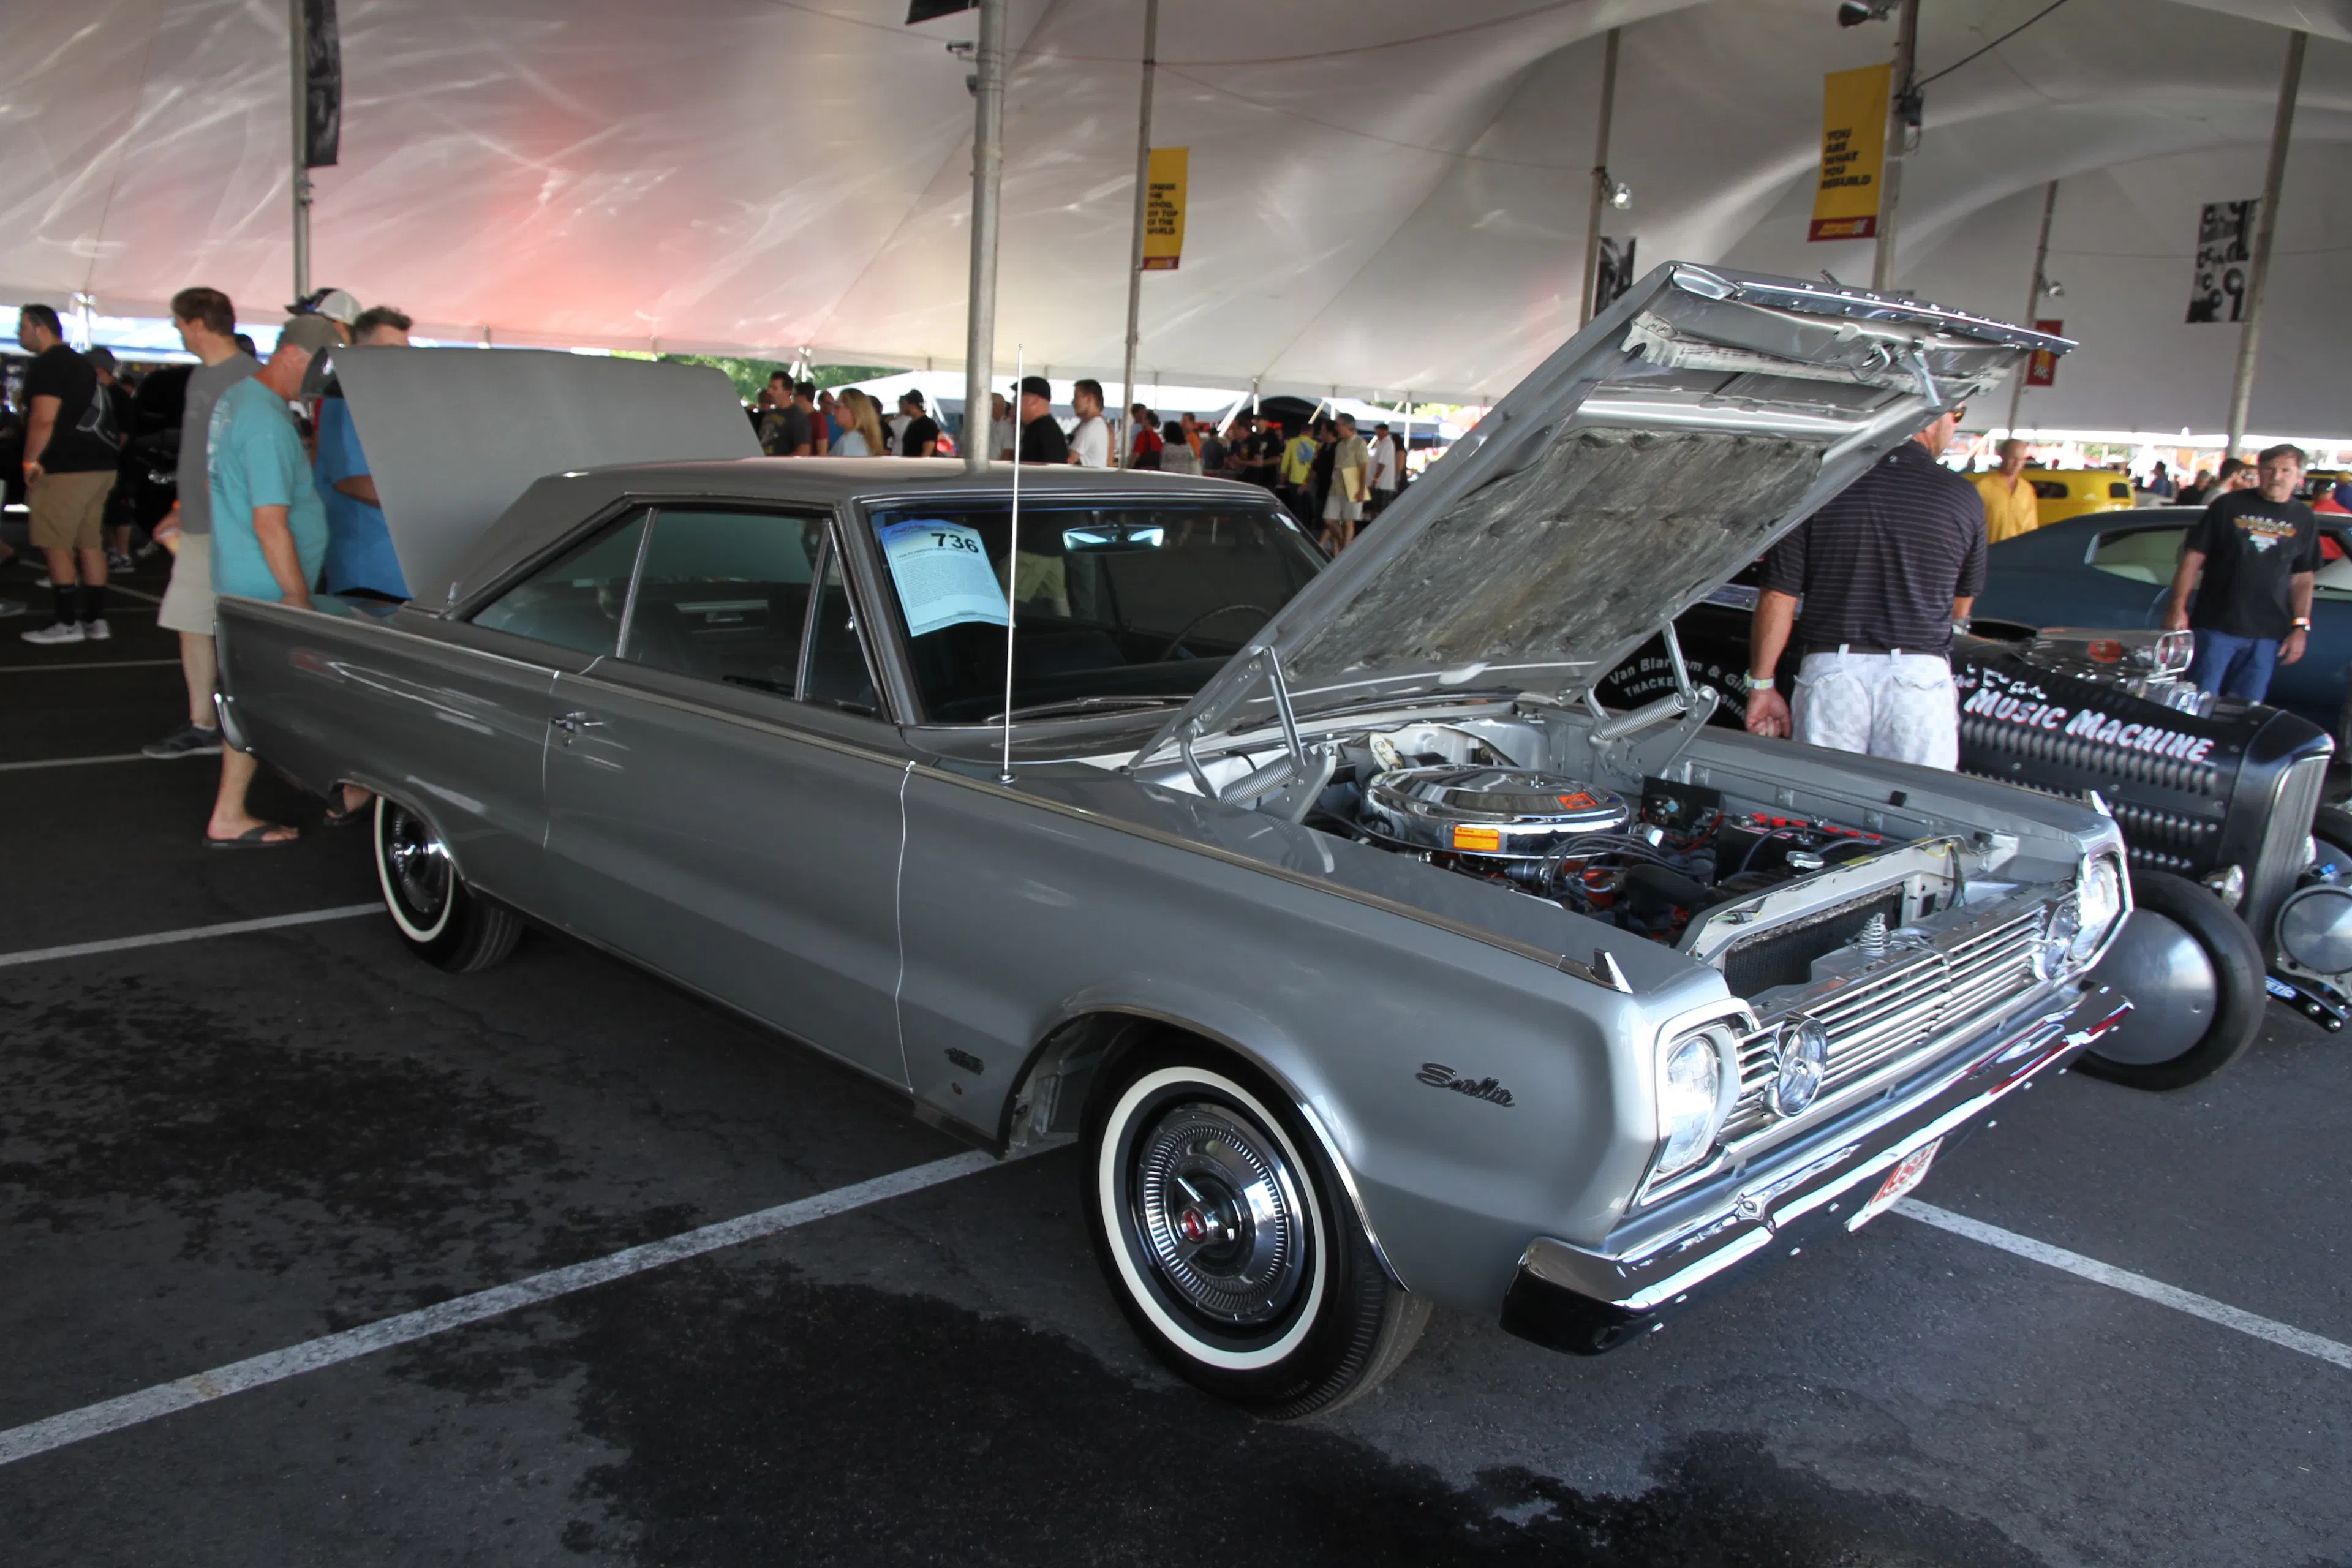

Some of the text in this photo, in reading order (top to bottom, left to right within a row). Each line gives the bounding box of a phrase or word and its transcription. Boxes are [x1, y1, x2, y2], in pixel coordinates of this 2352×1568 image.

[1826, 128, 1852, 140] YOU
[1825, 150, 1859, 165] WHAT
[930, 533, 979, 553] 736
[1609, 665, 1636, 685] Van
[1708, 665, 1721, 679] &
[1963, 687, 2215, 763] MUSIC MACHINE
[1415, 1063, 1516, 1107] Satellite
